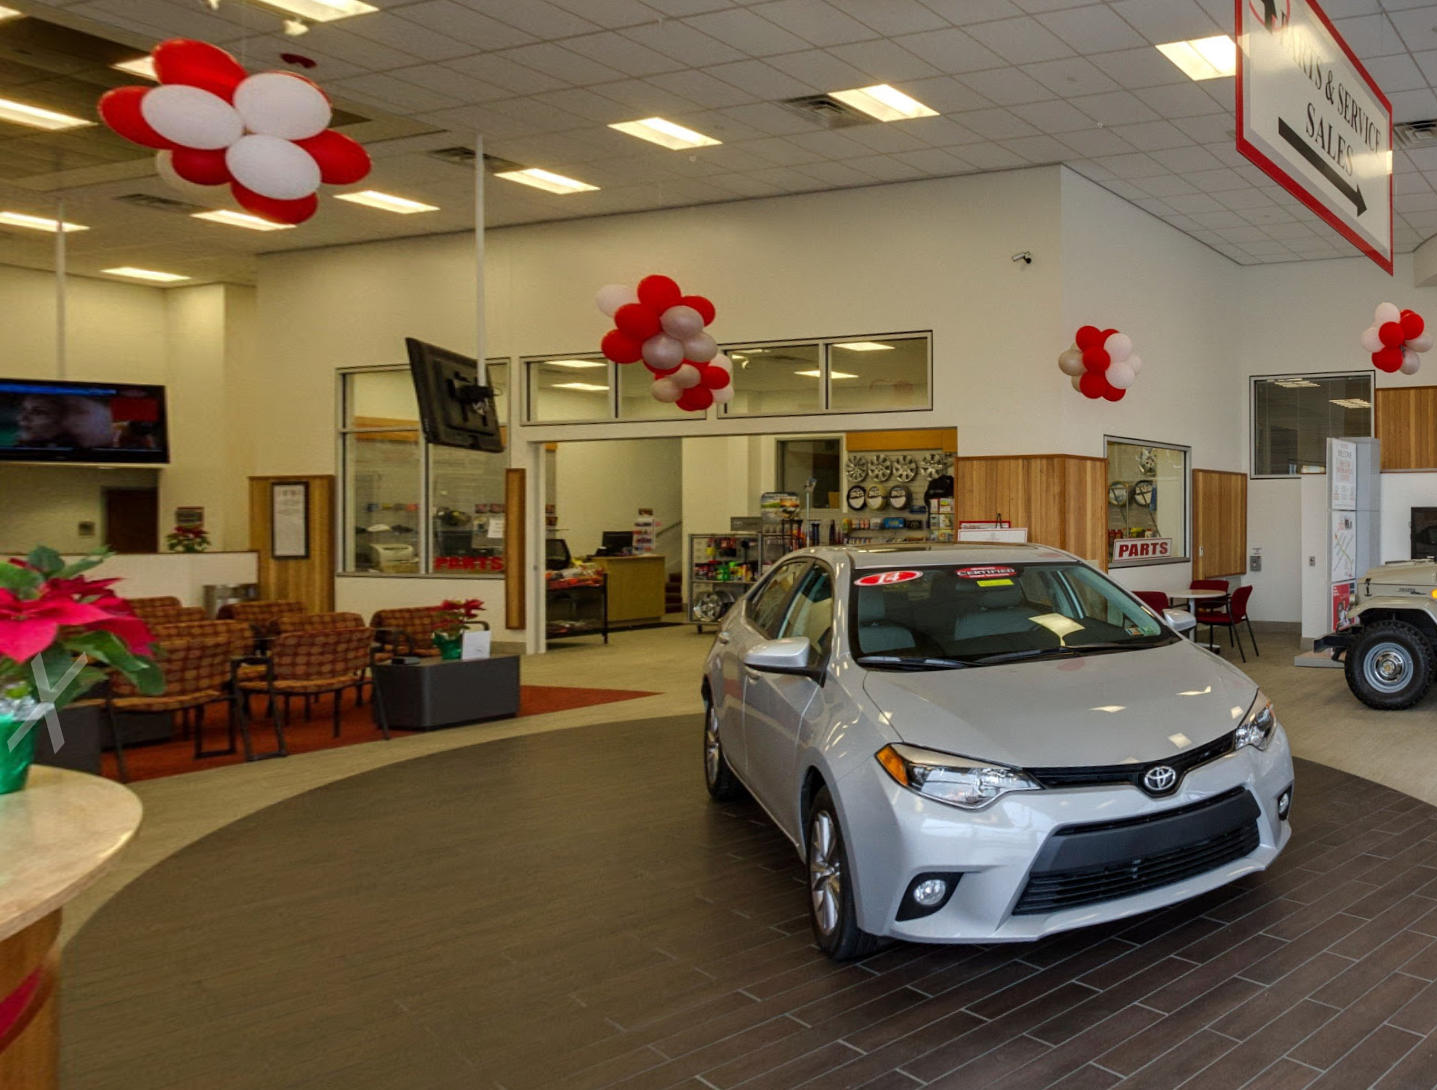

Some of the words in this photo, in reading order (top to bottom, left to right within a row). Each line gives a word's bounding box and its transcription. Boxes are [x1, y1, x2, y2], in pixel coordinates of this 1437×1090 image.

[1325, 70, 1335, 105] &
[1337, 83, 1381, 155] SERVICE
[1306, 102, 1354, 176] SALES
[433, 555, 504, 571] PARTS
[1118, 541, 1169, 558] PARTS
